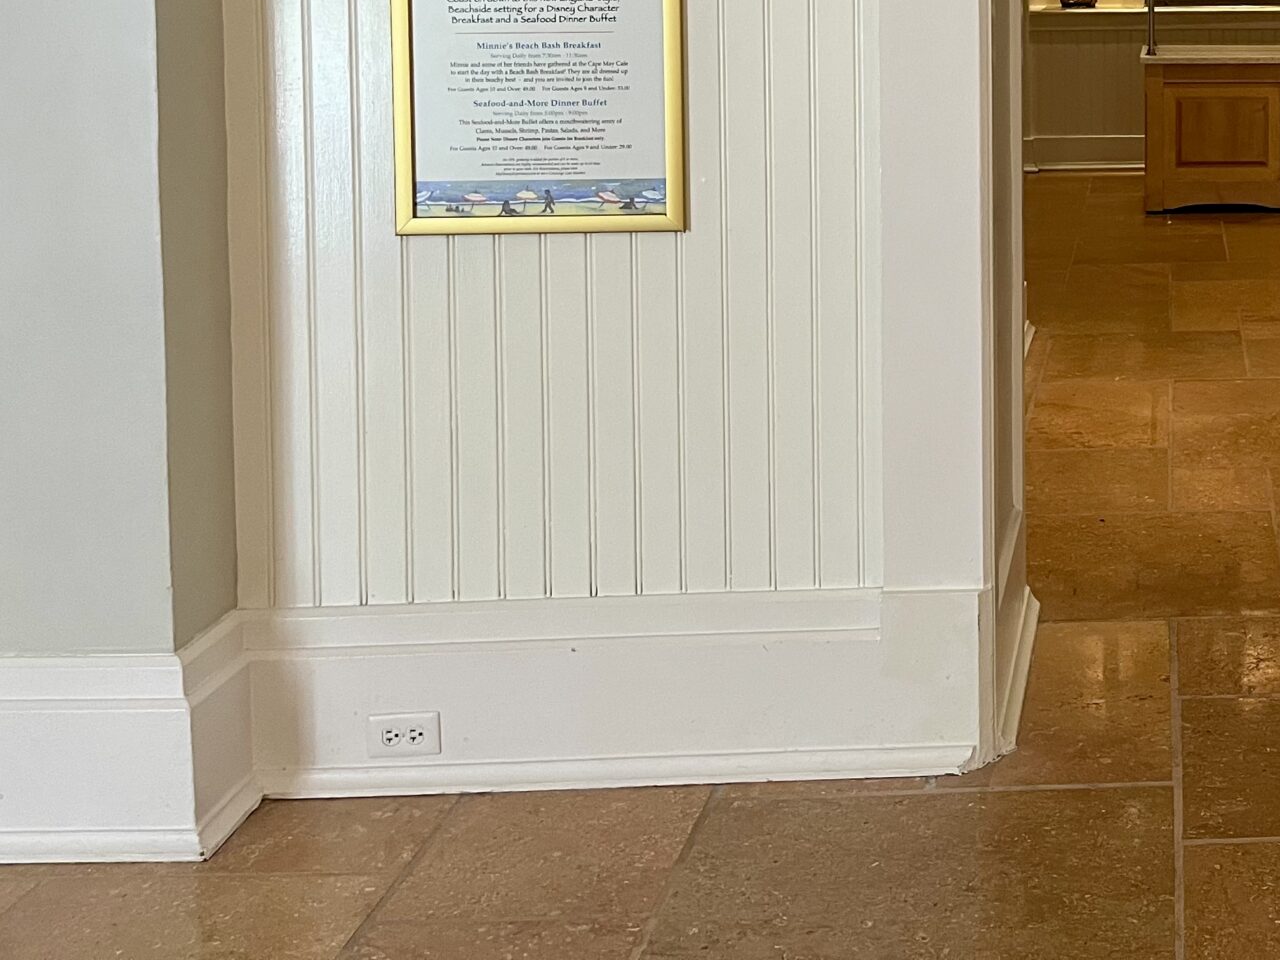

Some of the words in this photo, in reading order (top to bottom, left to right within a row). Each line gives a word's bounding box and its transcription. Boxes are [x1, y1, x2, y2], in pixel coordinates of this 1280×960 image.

[448, 4, 491, 13] Beachside
[494, 6, 522, 15] setting
[525, 3, 537, 13] for
[547, 5, 575, 15] Disney
[577, 3, 619, 12] Character
[452, 14, 493, 23] Breakfast
[495, 14, 511, 23] and
[520, 14, 557, 23] Seafood
[589, 13, 617, 22] Buffet
[473, 99, 549, 107] Seafood-and-More
[551, 99, 580, 107] Dinner
